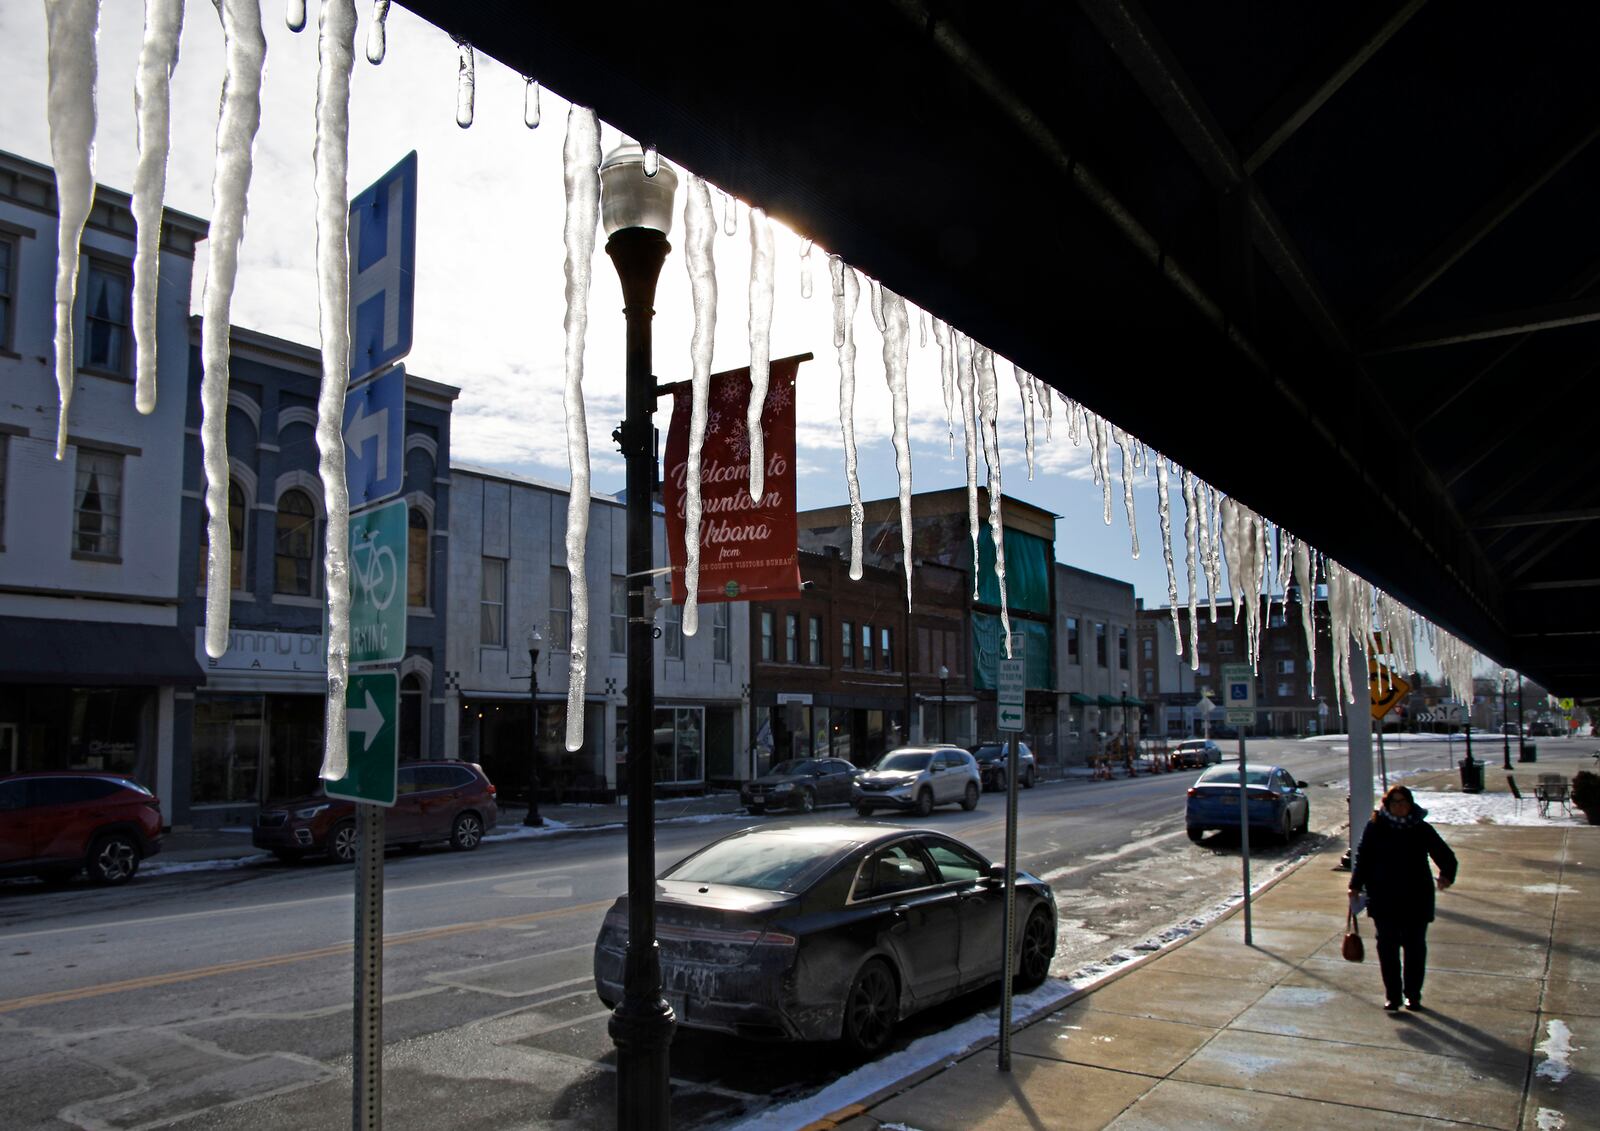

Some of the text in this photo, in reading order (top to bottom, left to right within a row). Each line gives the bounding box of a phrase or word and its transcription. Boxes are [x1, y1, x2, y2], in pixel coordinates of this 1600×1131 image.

[350, 175, 404, 369] H
[670, 452, 787, 490] Welcom to
[699, 519, 772, 548] Urbana
[709, 561, 734, 571] COUNTY
[736, 559, 764, 569] VISITORS
[766, 557, 793, 568] BUREAU
[718, 546, 741, 562] from
[352, 622, 388, 655] RKING
